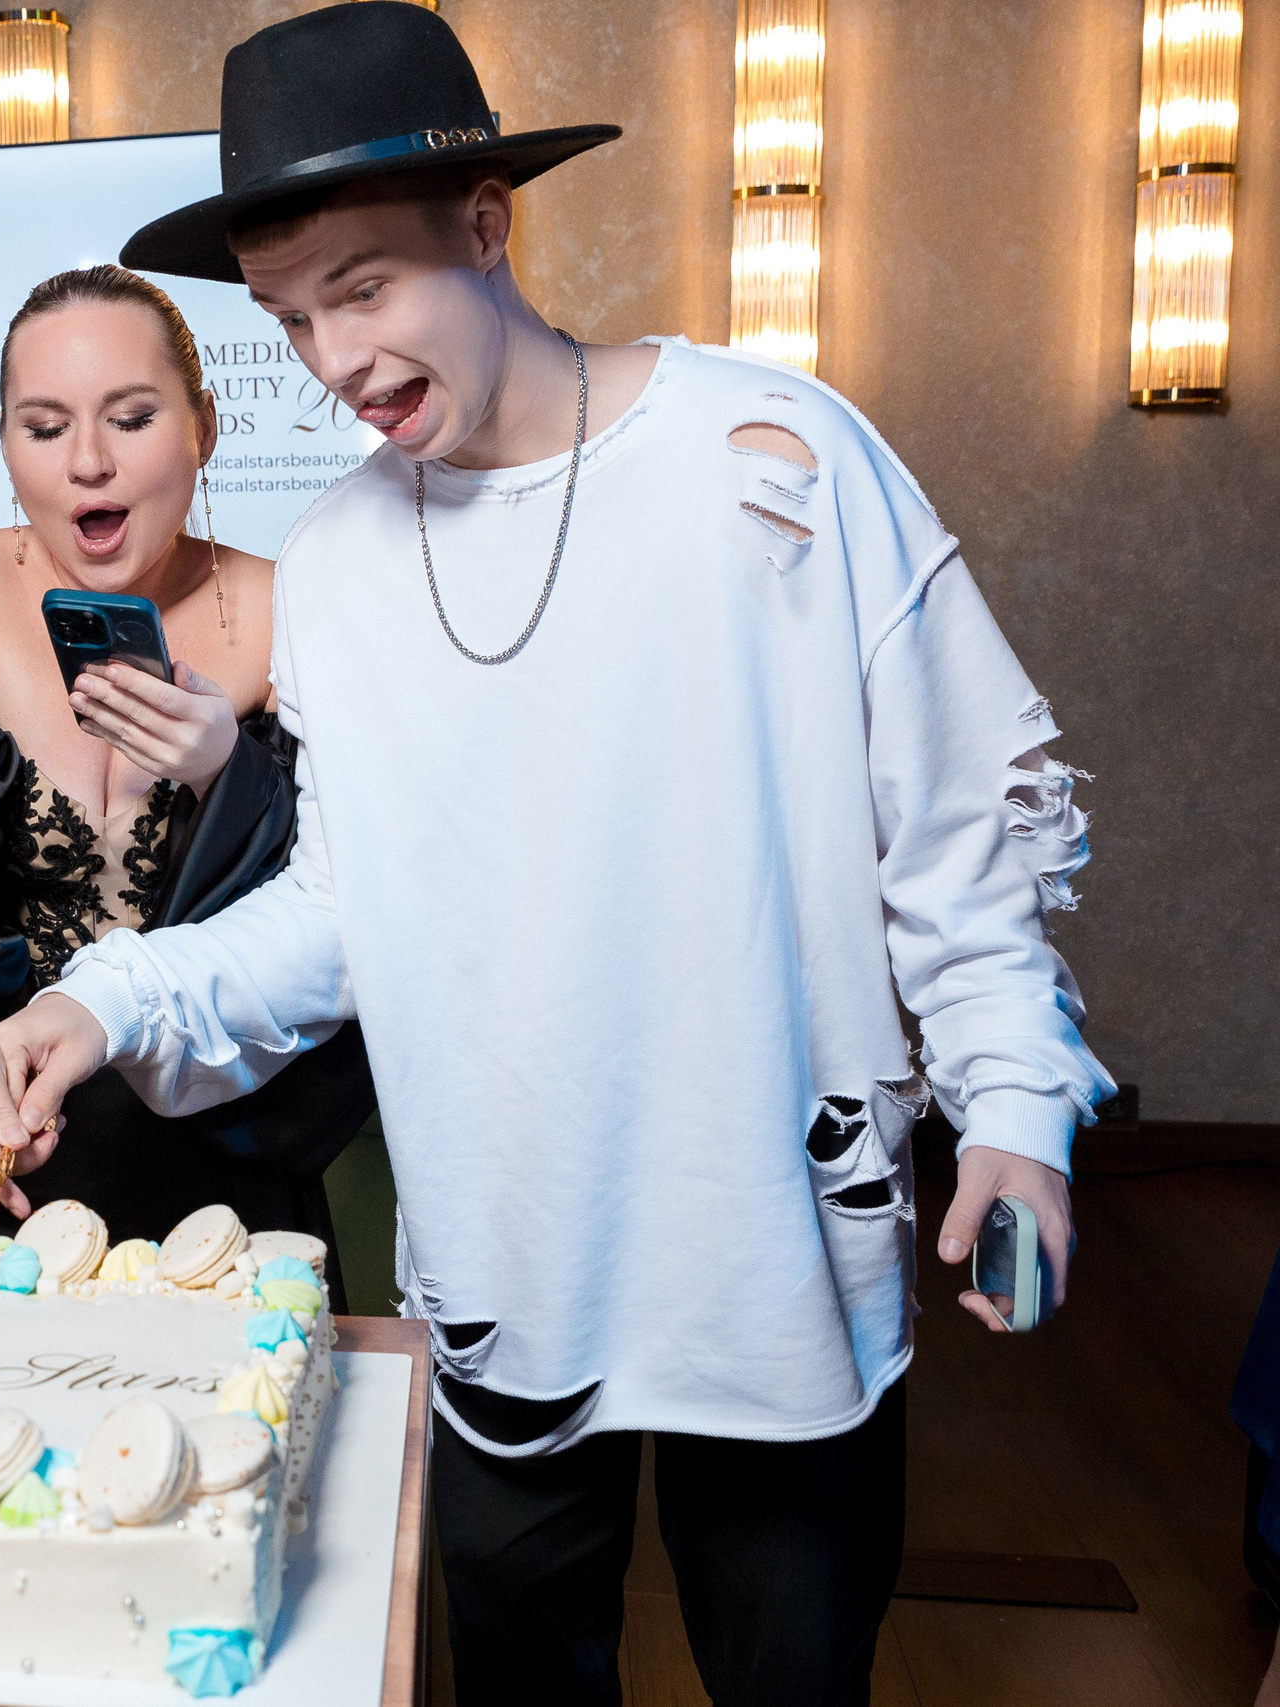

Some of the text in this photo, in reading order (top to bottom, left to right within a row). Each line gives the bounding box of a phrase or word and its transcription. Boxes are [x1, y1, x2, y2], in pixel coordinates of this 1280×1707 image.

[203, 340, 301, 366] MEDIC
[208, 376, 285, 402] AUTY
[289, 376, 357, 434] 20
[207, 453, 367, 471] dicalstarsbeautya
